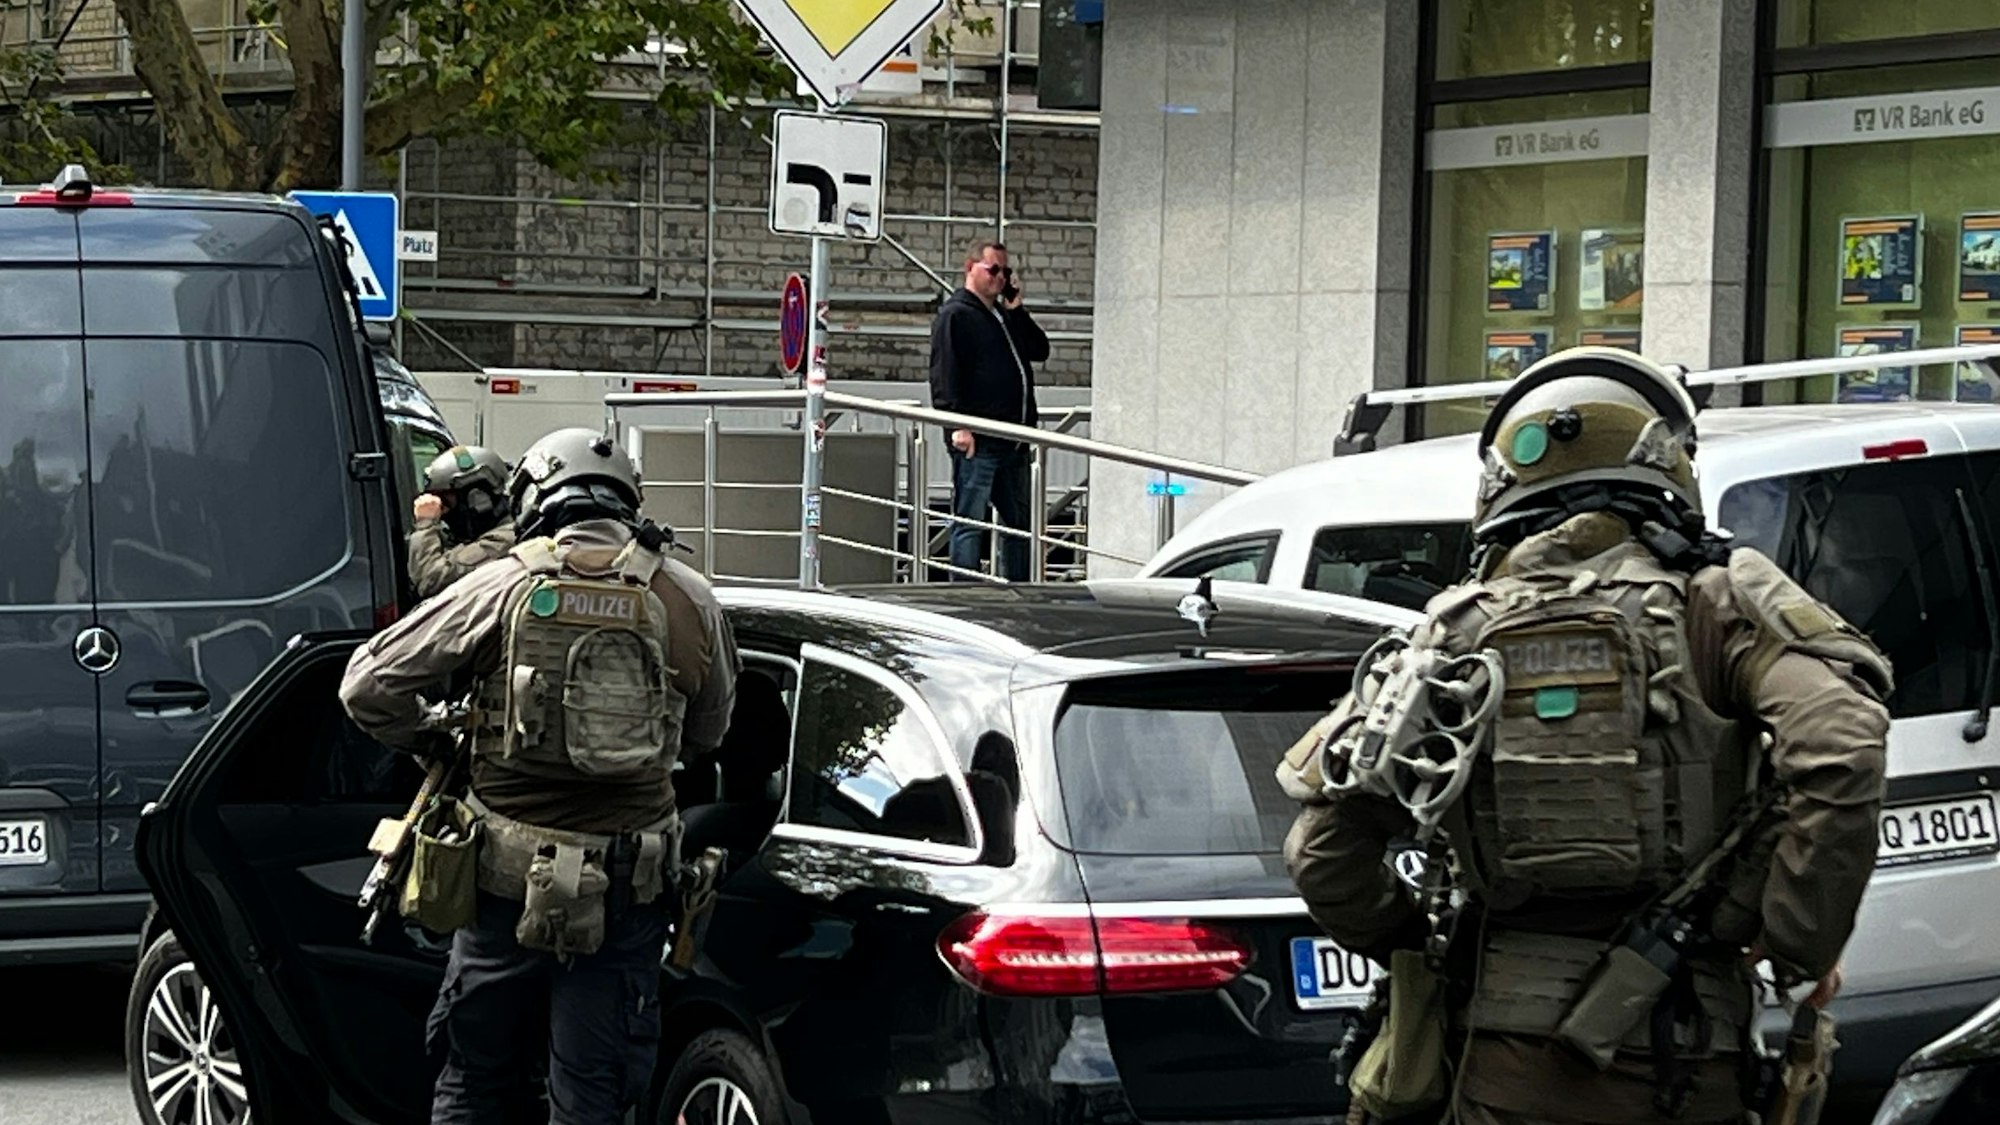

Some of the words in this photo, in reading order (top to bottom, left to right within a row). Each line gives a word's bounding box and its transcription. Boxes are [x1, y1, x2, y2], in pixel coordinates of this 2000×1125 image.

[1880, 105, 1905, 130] VR
[1910, 100, 1954, 128] Bank
[1958, 99, 1984, 125] eG
[1516, 132, 1536, 155] VR
[1540, 129, 1574, 153] Bank
[1580, 127, 1600, 151] eG
[403, 235, 434, 254] Platz
[562, 591, 636, 620] POLIZEI
[1505, 638, 1611, 674] POLIZEI
[1882, 815, 1904, 849] Q
[1908, 805, 1991, 847] 1801
[1318, 946, 1370, 990] DO
